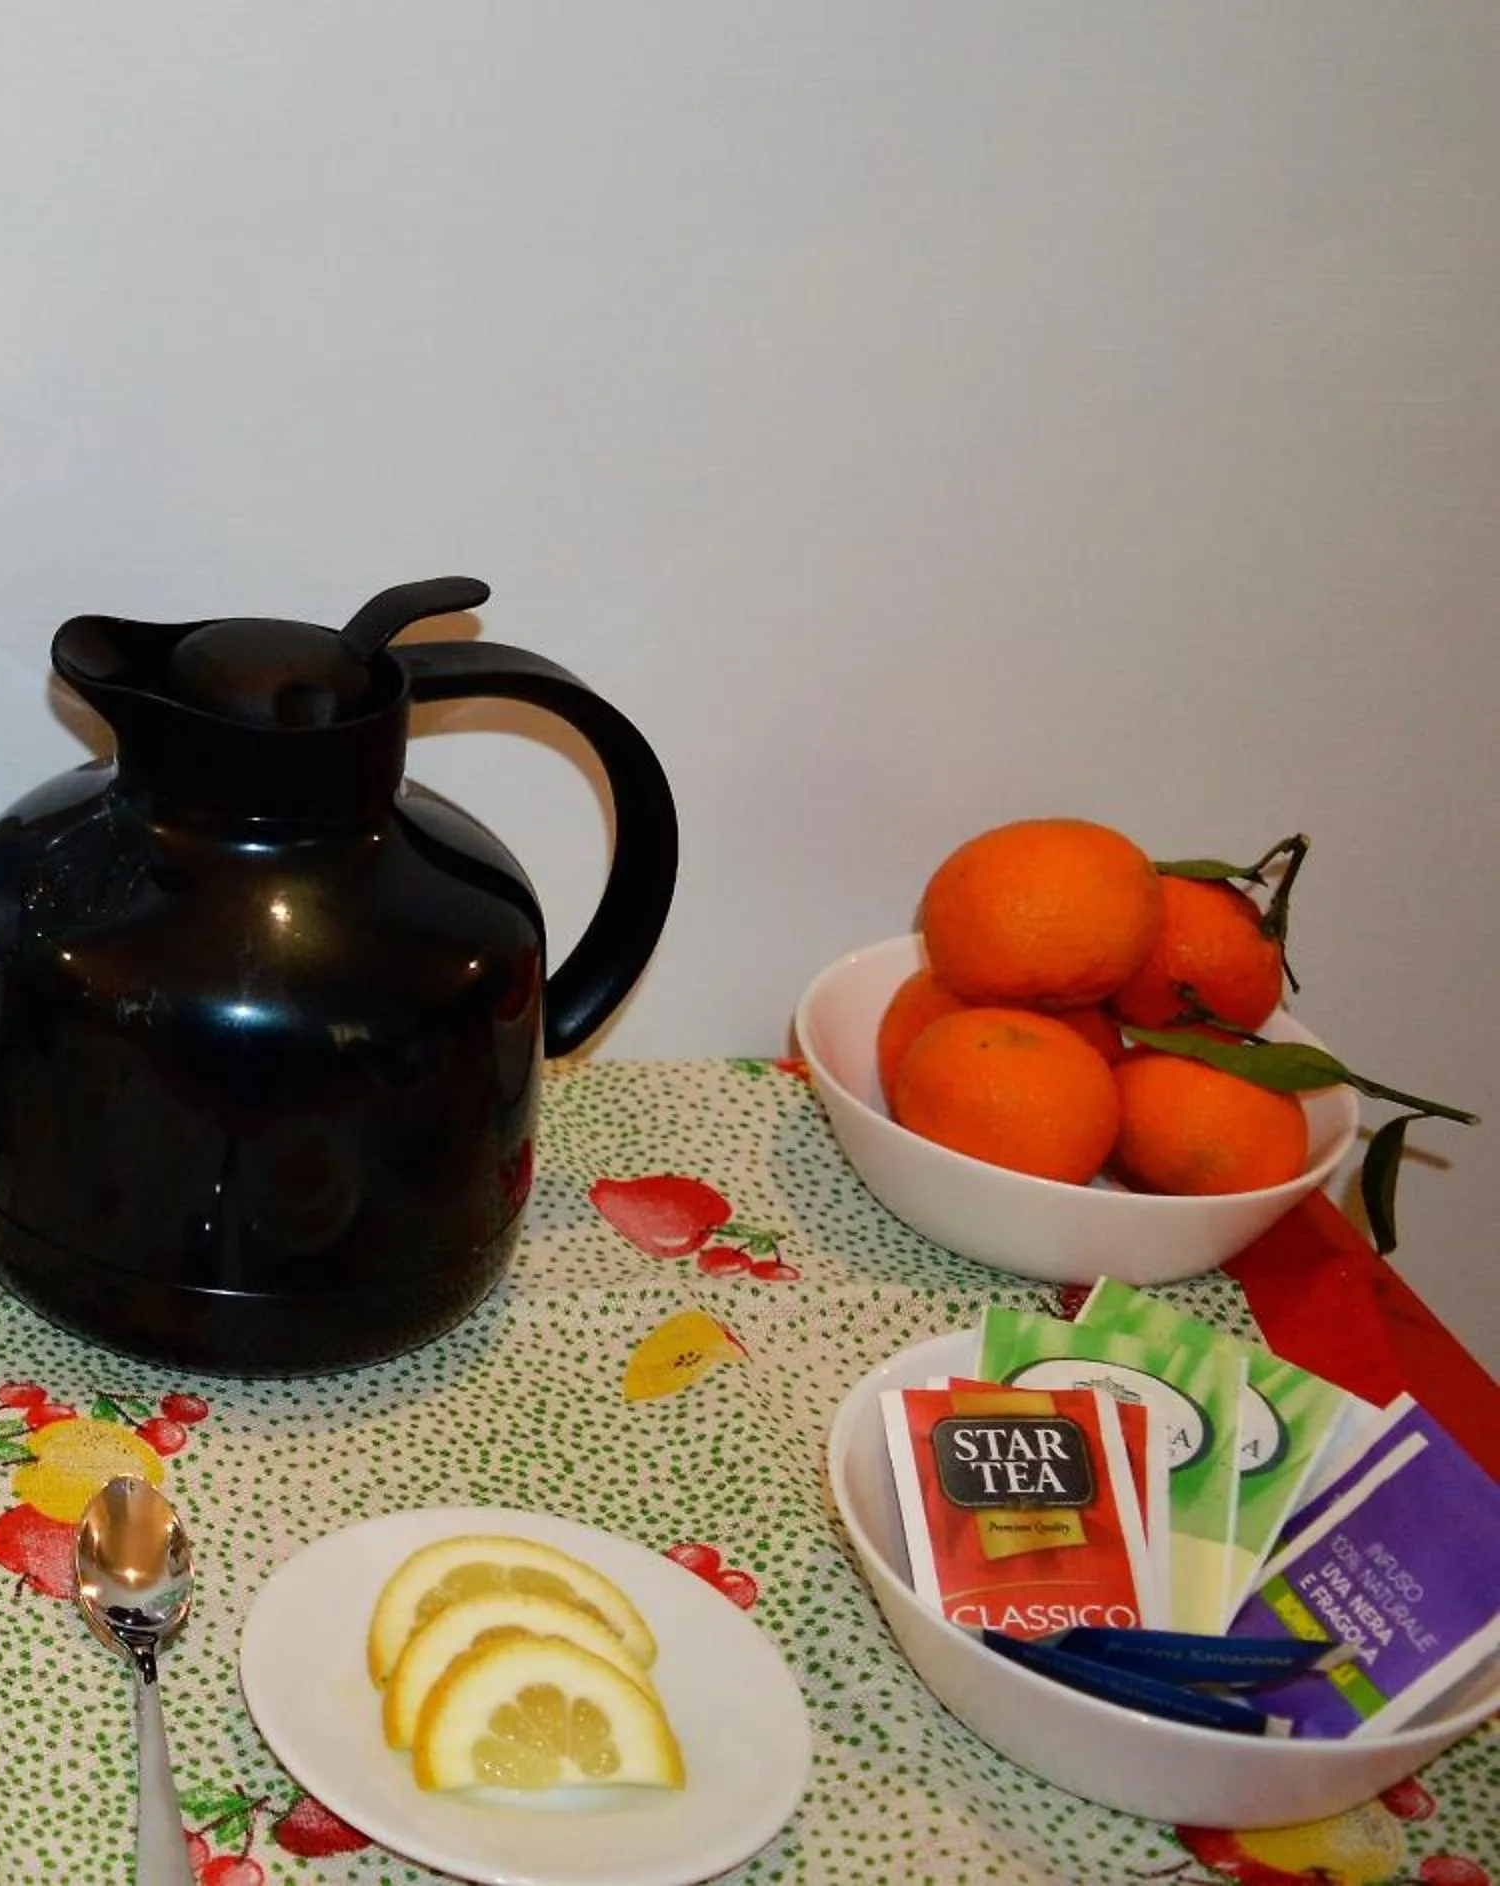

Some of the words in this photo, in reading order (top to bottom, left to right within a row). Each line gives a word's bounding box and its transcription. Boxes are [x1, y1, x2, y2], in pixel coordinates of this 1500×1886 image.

[953, 1428, 1070, 1460] STAR
[970, 1461, 1067, 1493] TEA
[951, 1605, 1137, 1631] CLASSICO
[1349, 1593, 1394, 1647] NERA
